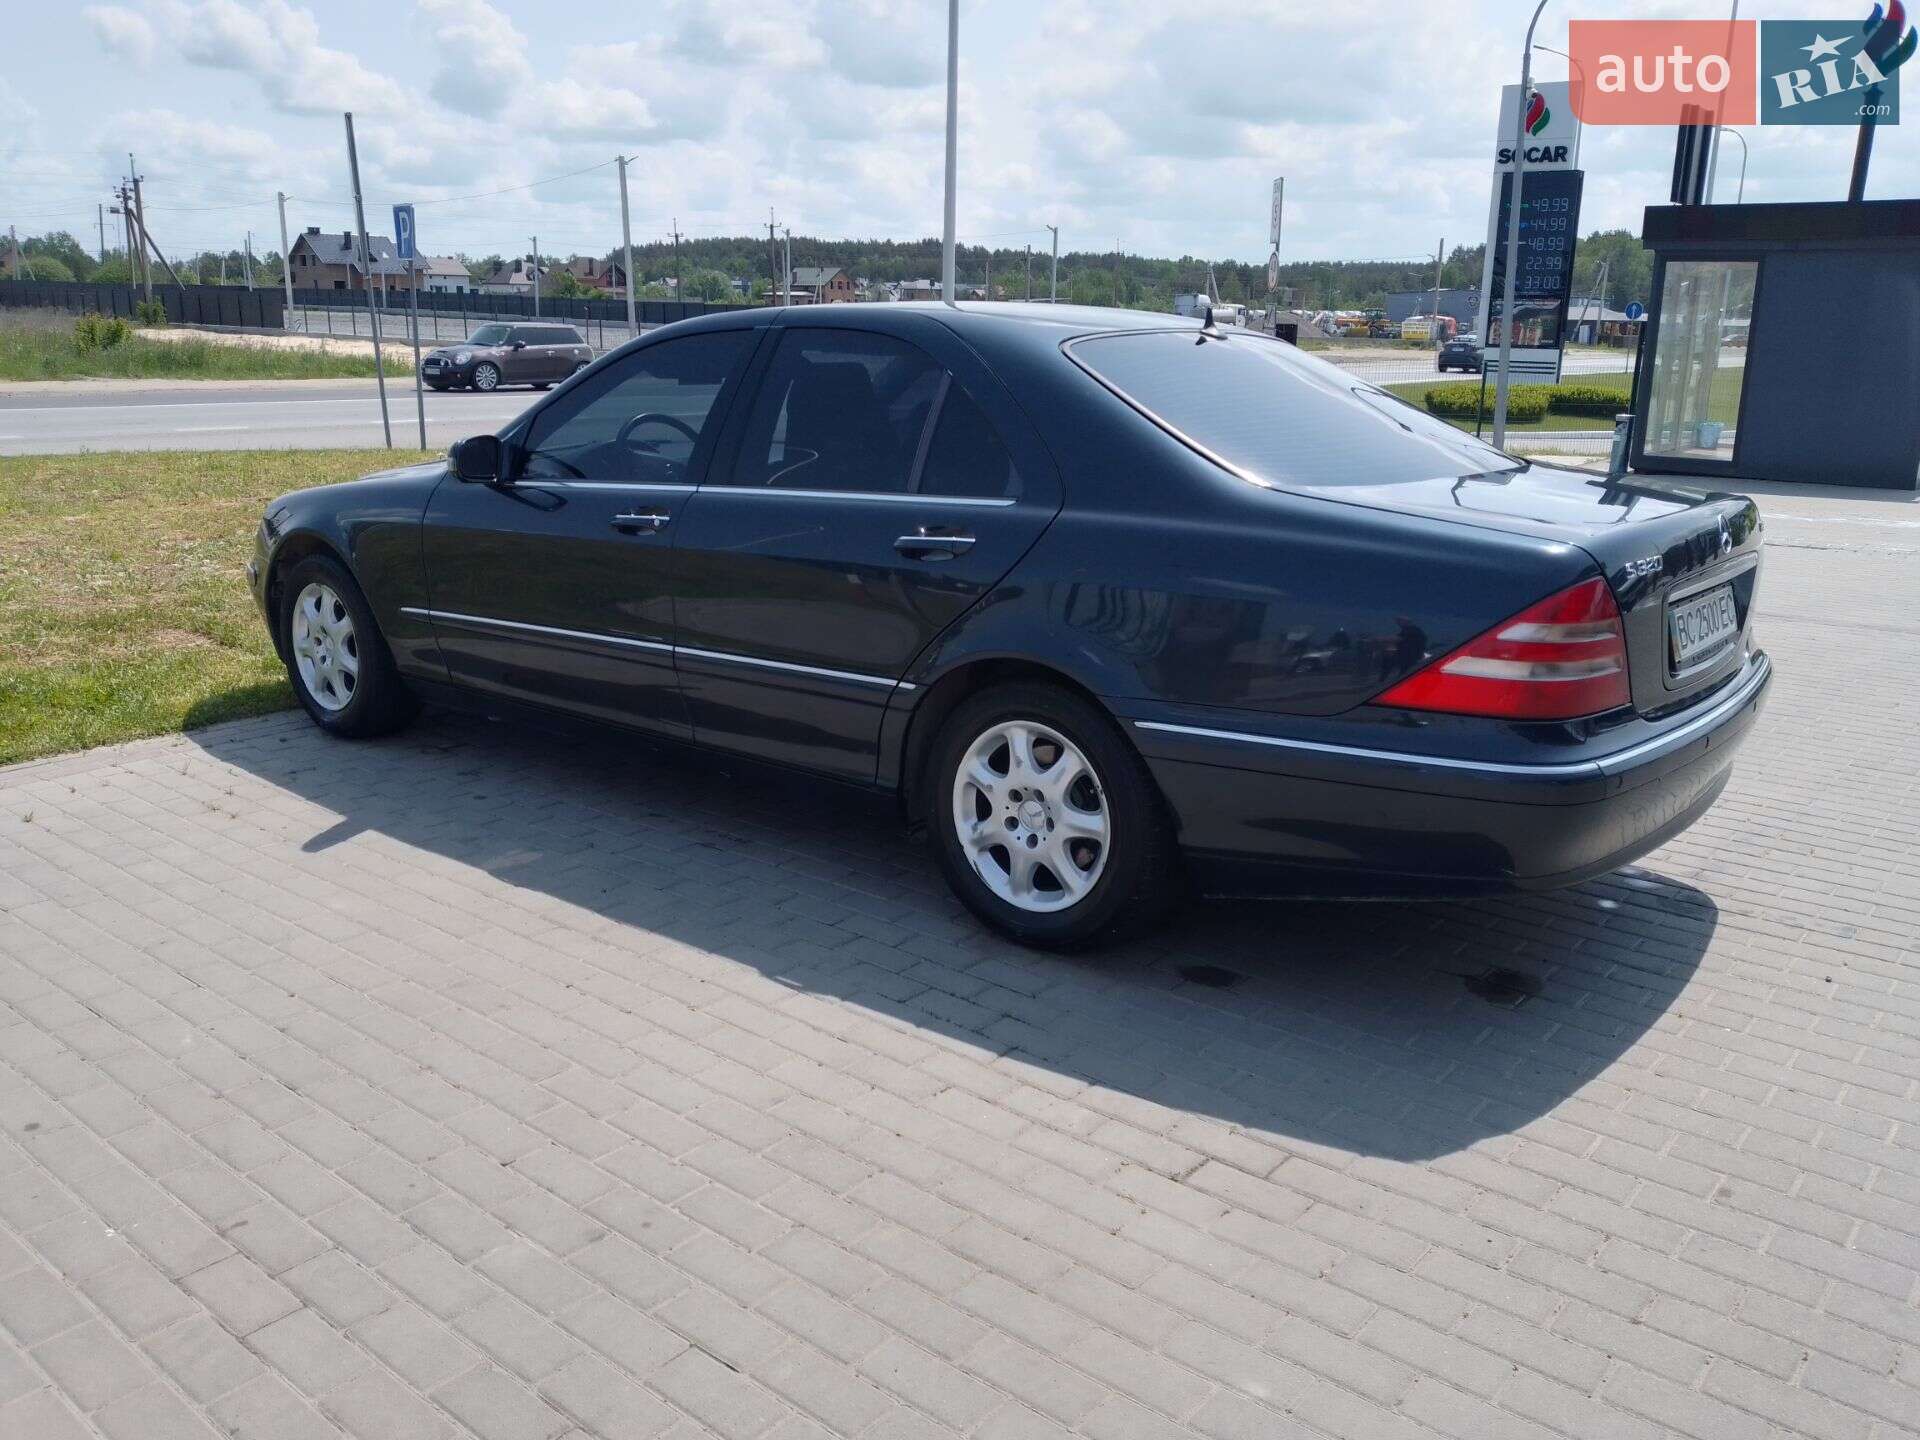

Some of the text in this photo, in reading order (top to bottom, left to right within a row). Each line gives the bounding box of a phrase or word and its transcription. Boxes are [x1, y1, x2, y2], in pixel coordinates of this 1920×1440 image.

[1532, 198, 1569, 212] 49.99
[1530, 217, 1566, 231] 44.99
[398, 211, 410, 254] P
[1528, 237, 1564, 251] 48.99
